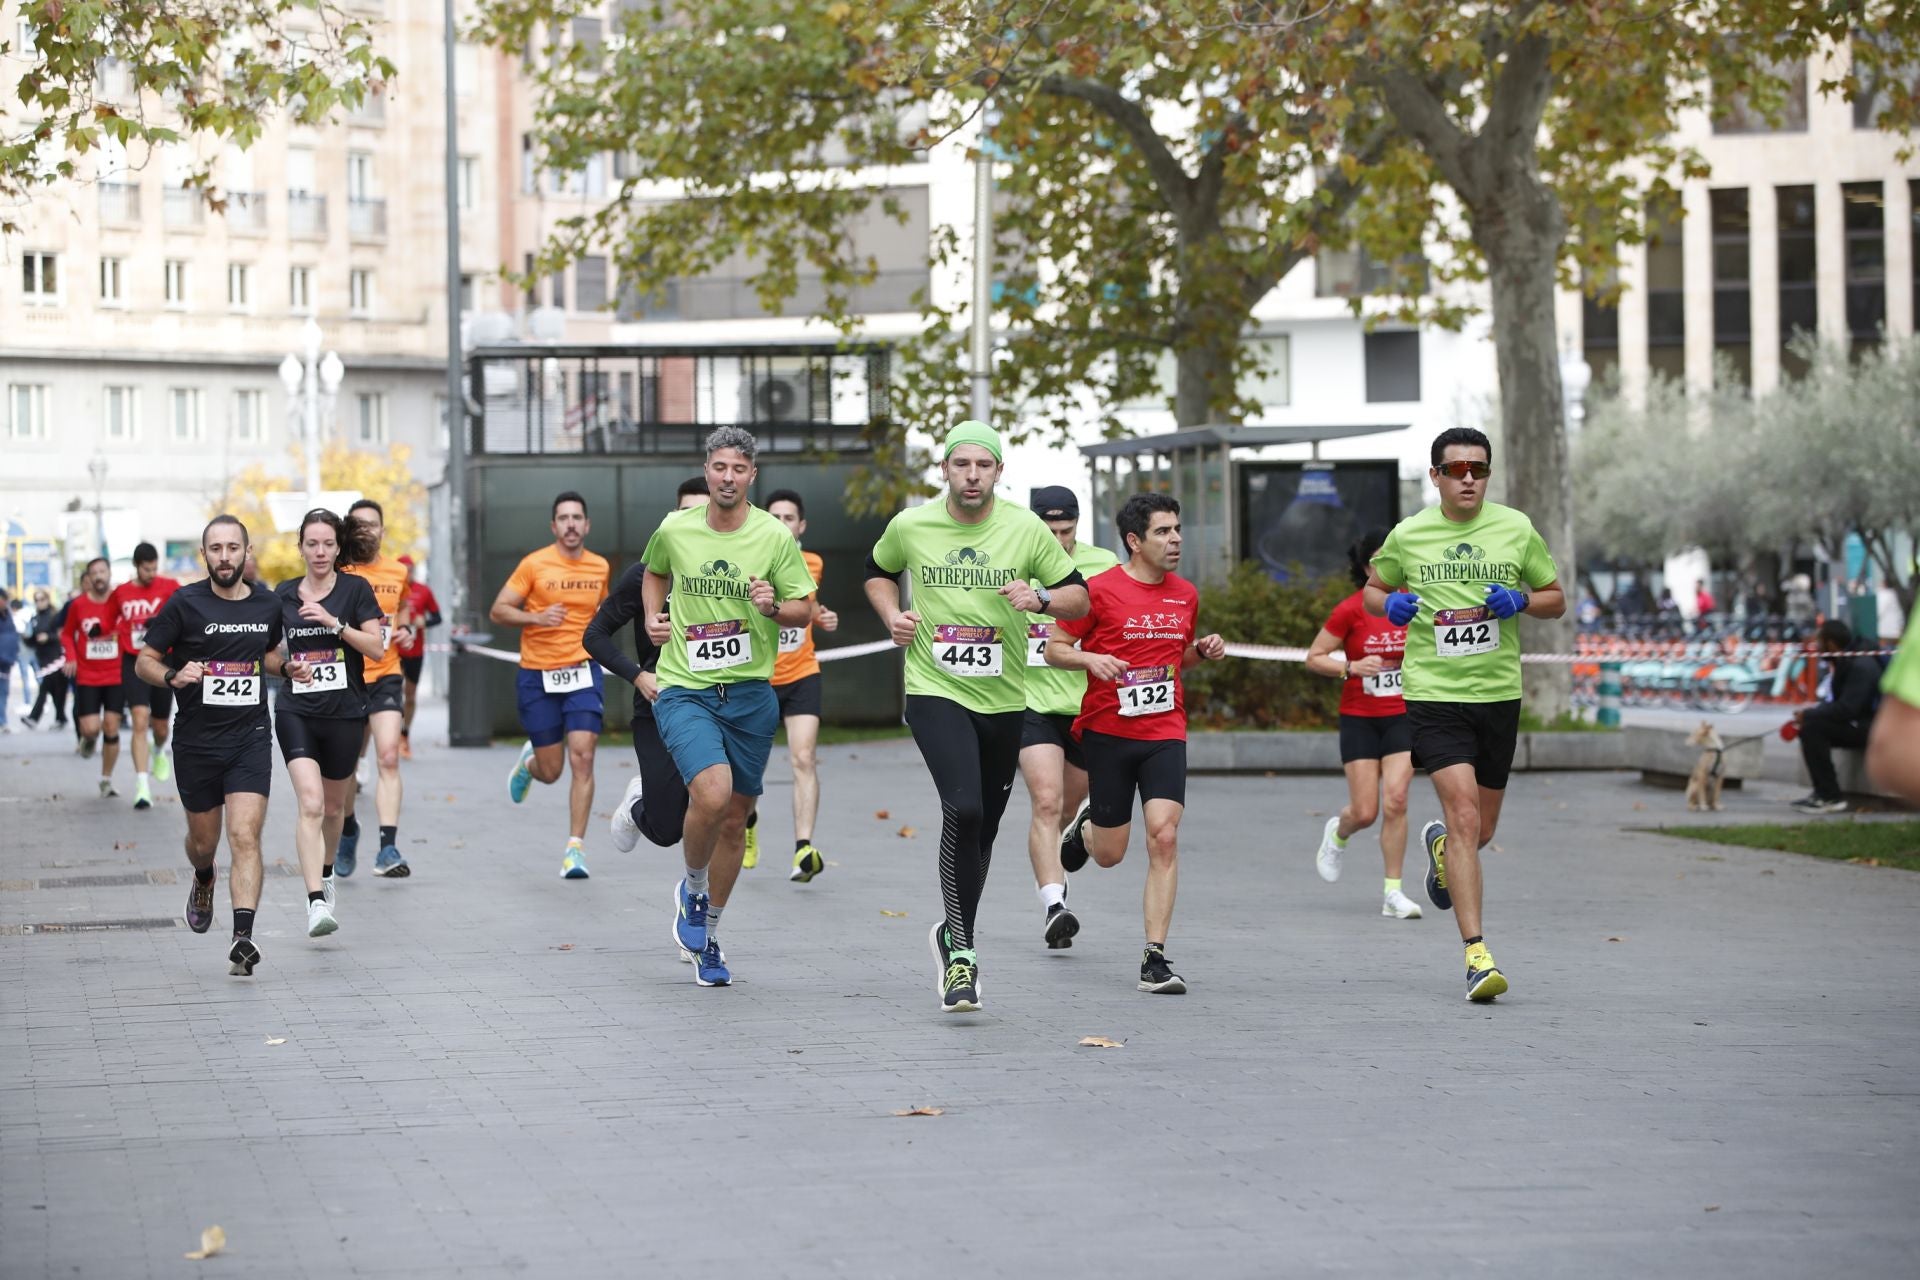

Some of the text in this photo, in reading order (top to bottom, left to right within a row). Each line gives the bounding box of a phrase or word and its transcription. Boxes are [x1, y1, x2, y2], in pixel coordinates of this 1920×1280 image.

[921, 565, 1017, 587] ENTREPINARES
[1420, 562, 1511, 583] ENTREPINARES
[681, 574, 750, 599] ENTREPINAR
[219, 623, 269, 634] DECATHLON
[296, 626, 331, 638] DECATH
[779, 629, 798, 645] 92
[1122, 631, 1184, 640] Sports Santander
[1443, 623, 1491, 647] 442
[696, 637, 741, 661] 450
[941, 645, 992, 667] 443
[312, 665, 337, 682] 43
[552, 670, 579, 686] 991
[212, 678, 252, 696] 242
[1127, 684, 1168, 707] 132
